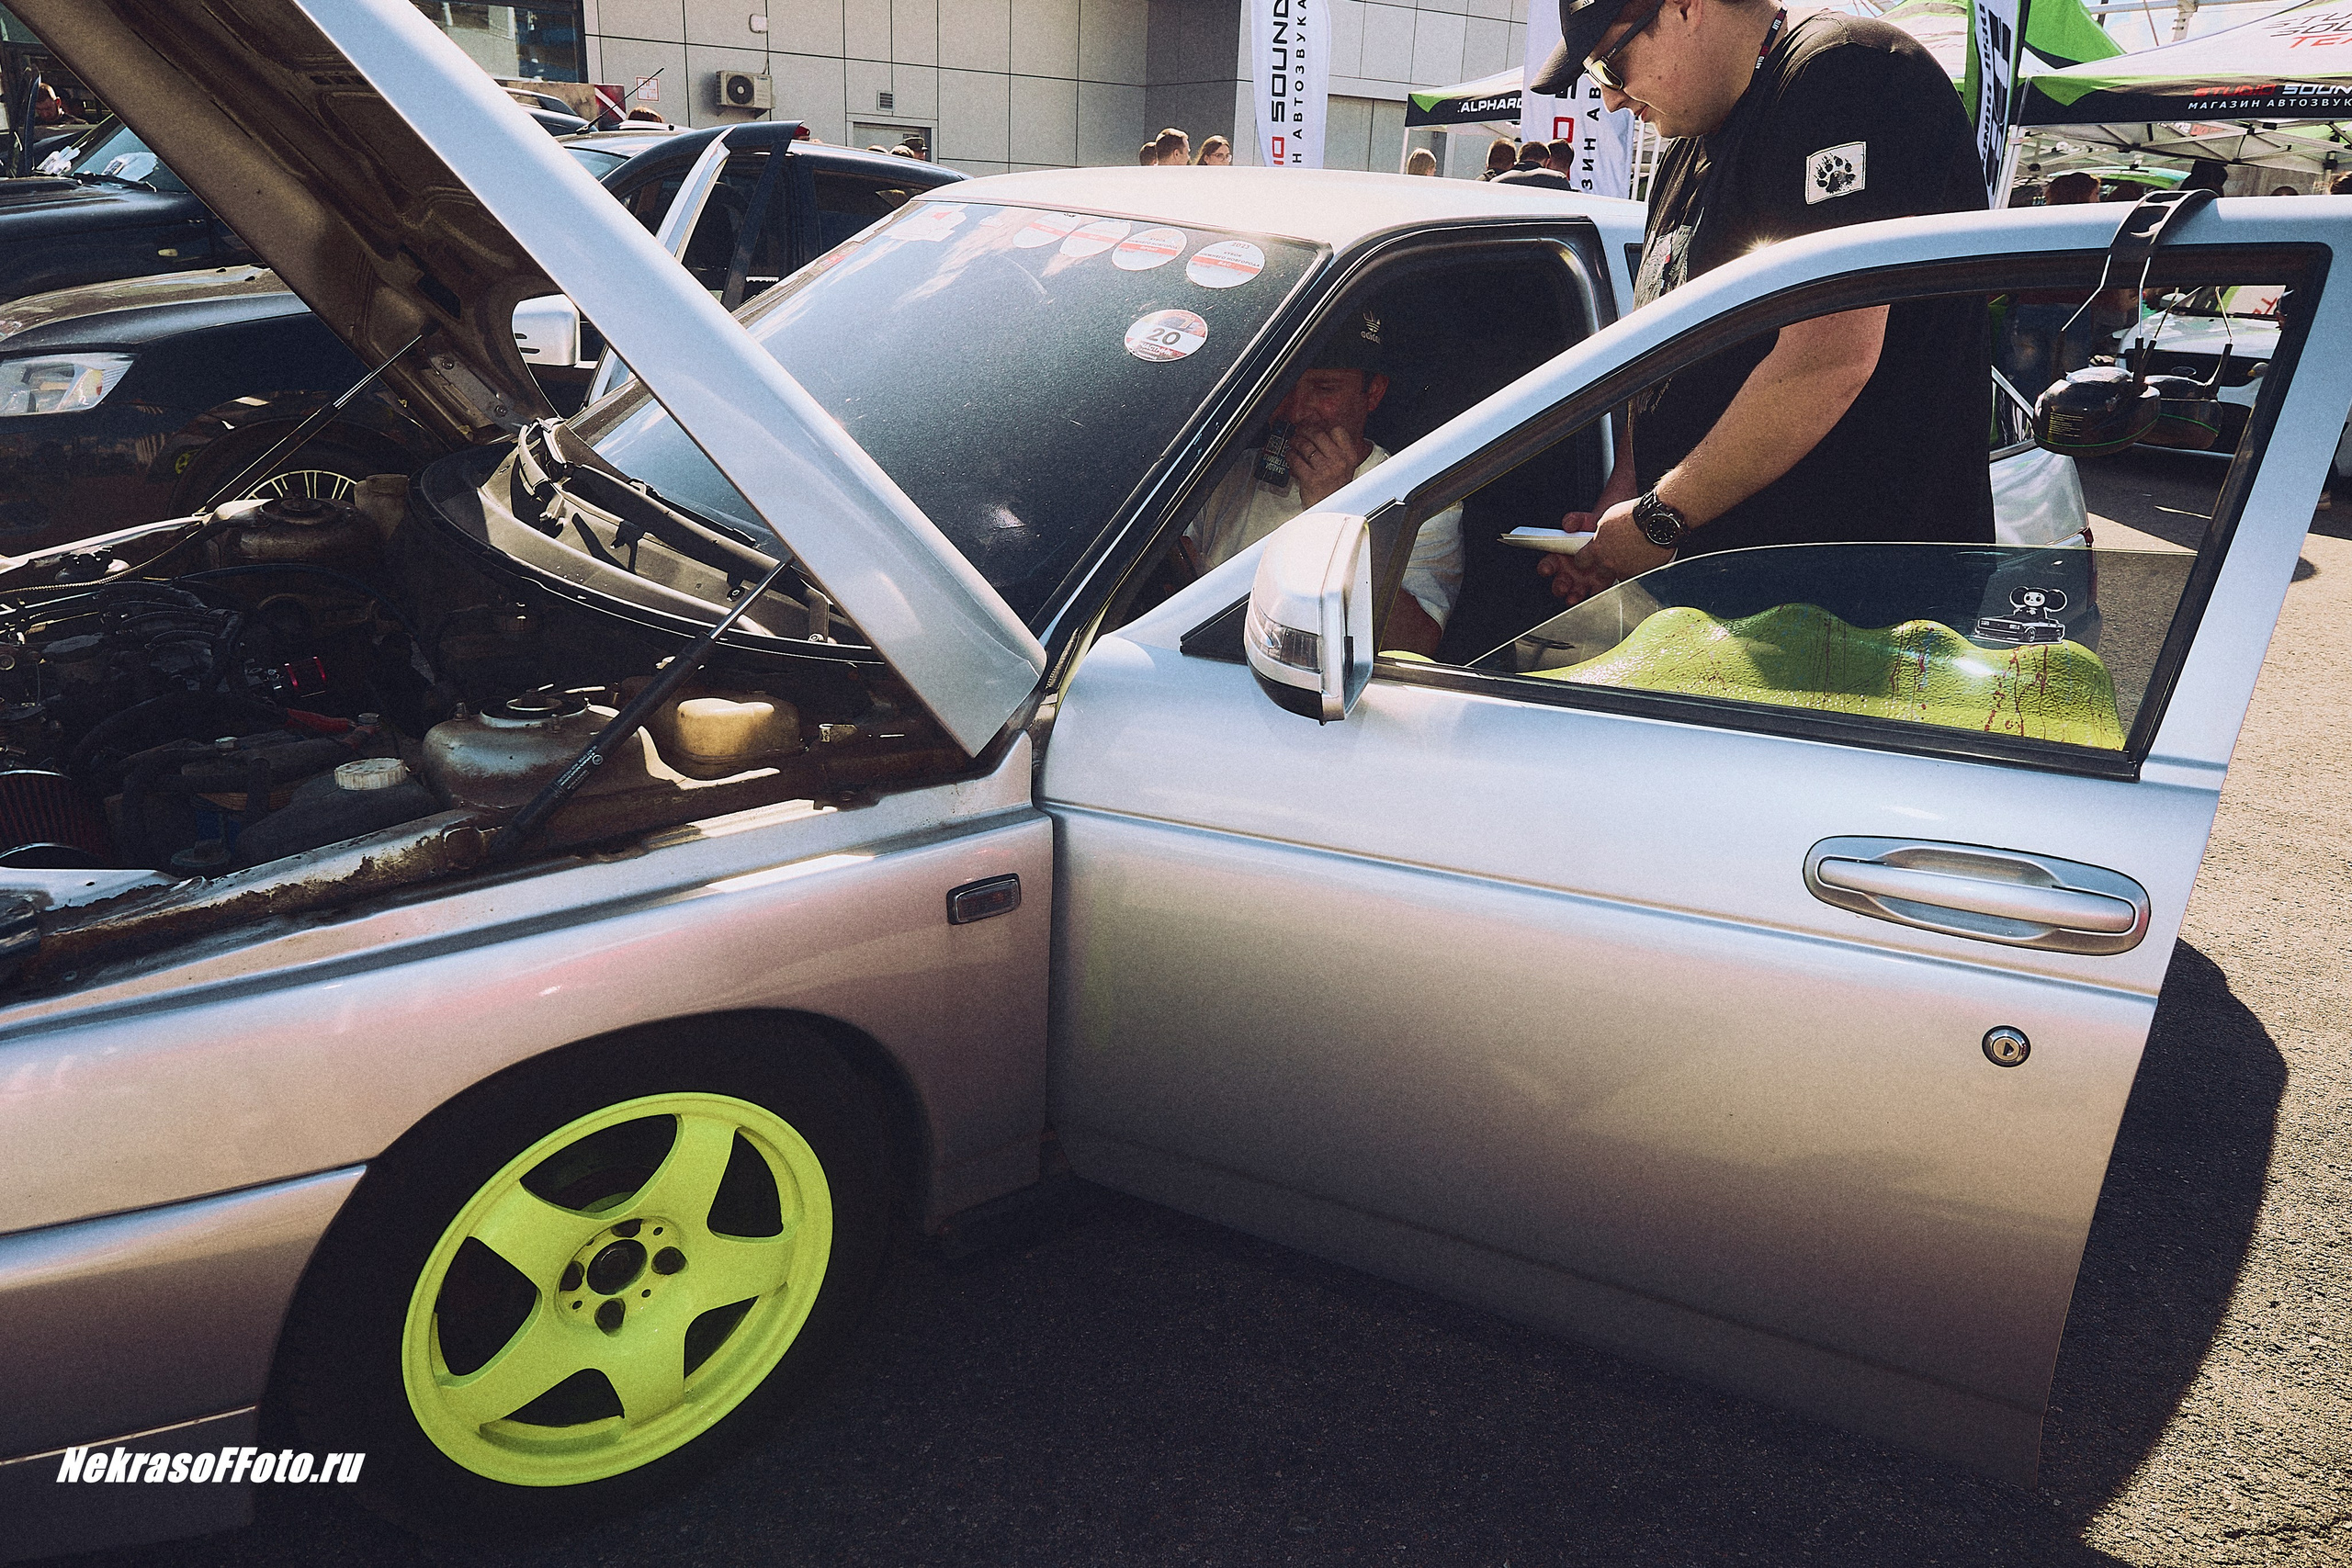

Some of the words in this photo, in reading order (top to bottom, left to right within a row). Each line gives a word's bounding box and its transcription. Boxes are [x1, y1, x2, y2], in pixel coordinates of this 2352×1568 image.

[1271, 0, 1289, 123] SOUND
[1292, 0, 1307, 140] АВТОЗВУКА
[2192, 84, 2278, 97] STUDIO
[2188, 99, 2261, 110] МАГАЗИН
[1146, 327, 1182, 345] 20
